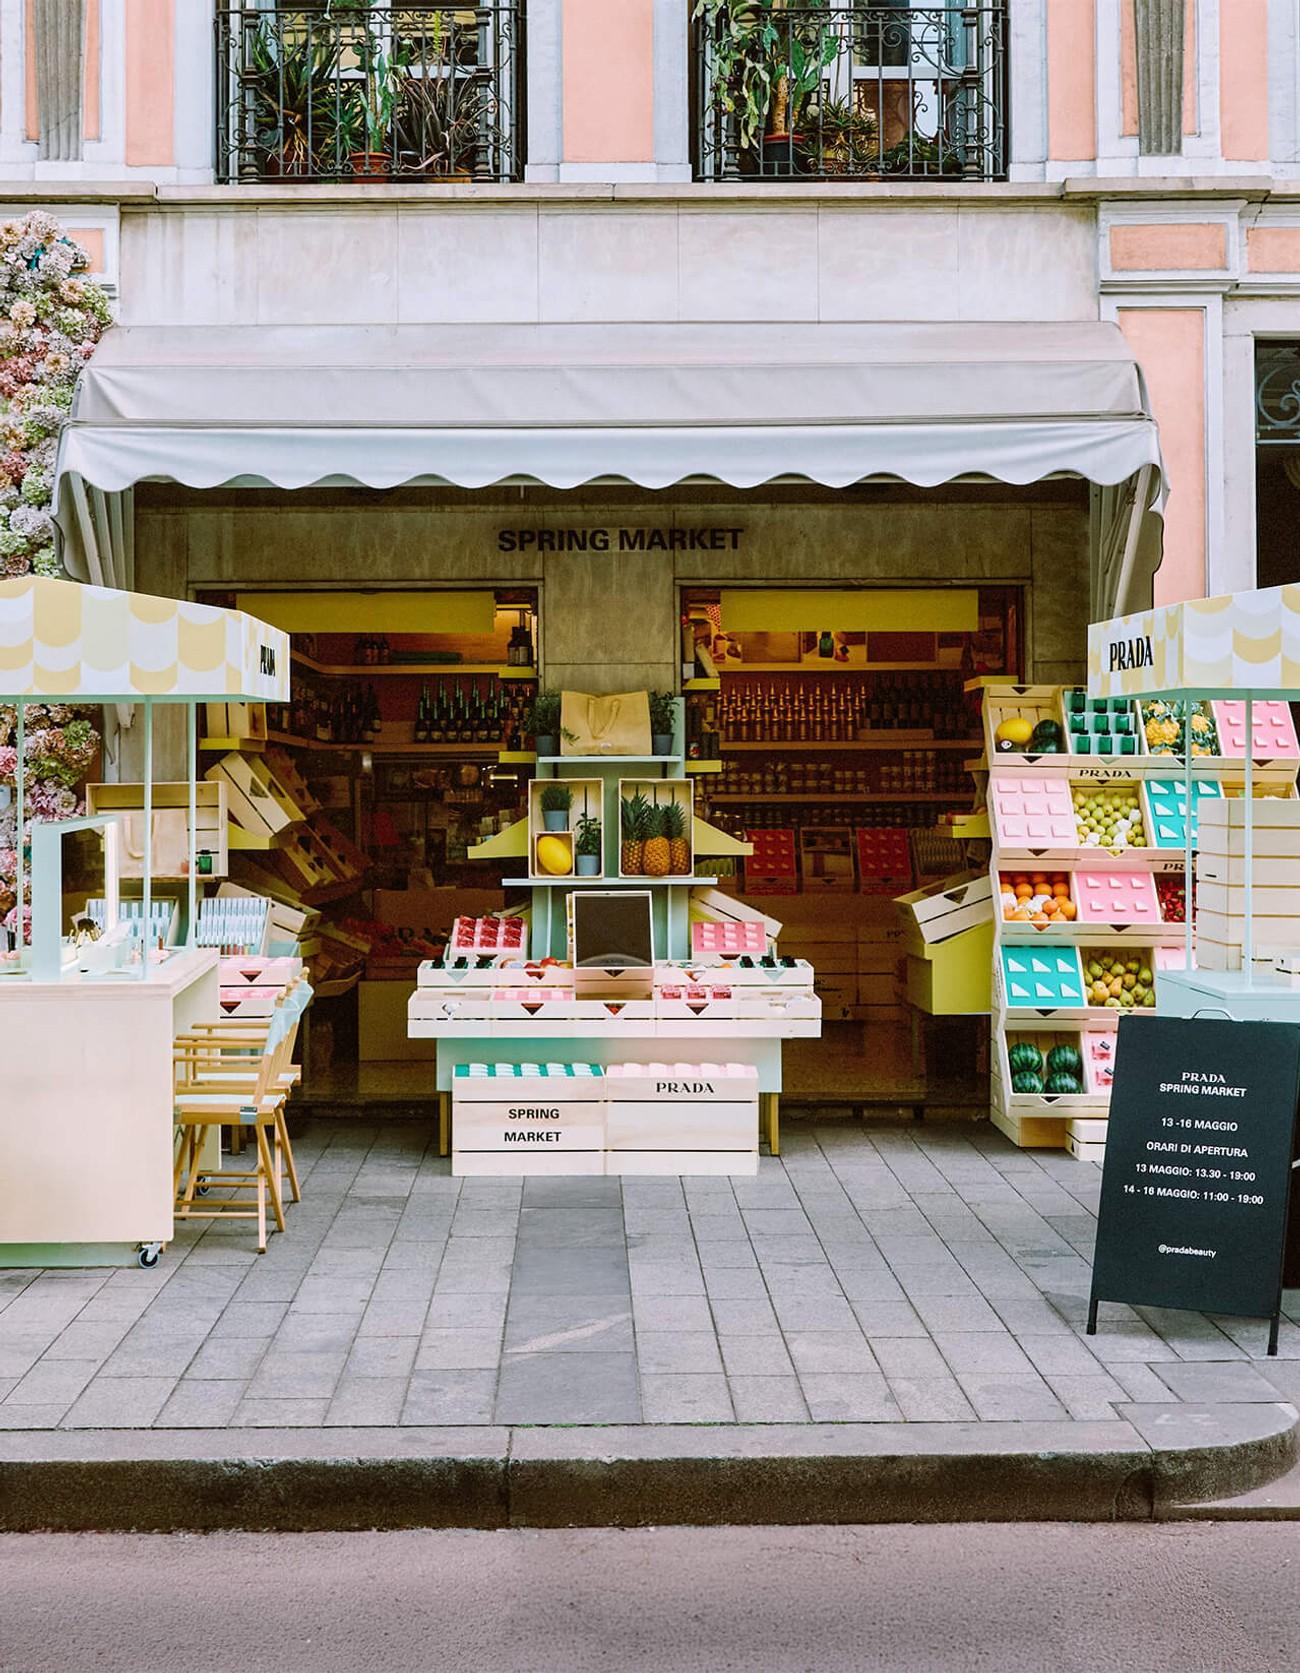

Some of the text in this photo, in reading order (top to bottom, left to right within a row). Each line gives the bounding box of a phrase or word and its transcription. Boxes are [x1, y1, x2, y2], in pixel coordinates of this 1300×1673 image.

[498, 528, 744, 552] SPRING MARKET
[1109, 635, 1154, 672] PRADA
[1079, 769, 1131, 778] PRADA
[1181, 1072, 1226, 1083] PRADA
[656, 1082, 714, 1093] PRADA
[1159, 1083, 1247, 1097] SPRING MARKET
[508, 1108, 560, 1120] SPRING
[1161, 1117, 1173, 1127] 13
[1194, 1120, 1238, 1132] MAGGIO
[504, 1131, 562, 1142] MARKET
[1146, 1141, 1249, 1157] ORARI DI APERTURA
[1135, 1163, 1147, 1173] 13
[1149, 1164, 1193, 1176] MAGGIO:
[1230, 1171, 1256, 1182] 19:00
[1123, 1184, 1135, 1193] 14
[1143, 1186, 1155, 1195] 16
[1156, 1187, 1200, 1199] MAGGIO:
[1203, 1191, 1229, 1202] 11:00
[1238, 1194, 1264, 1205] 19:00
[1158, 1243, 1217, 1258] @pradabeauty
